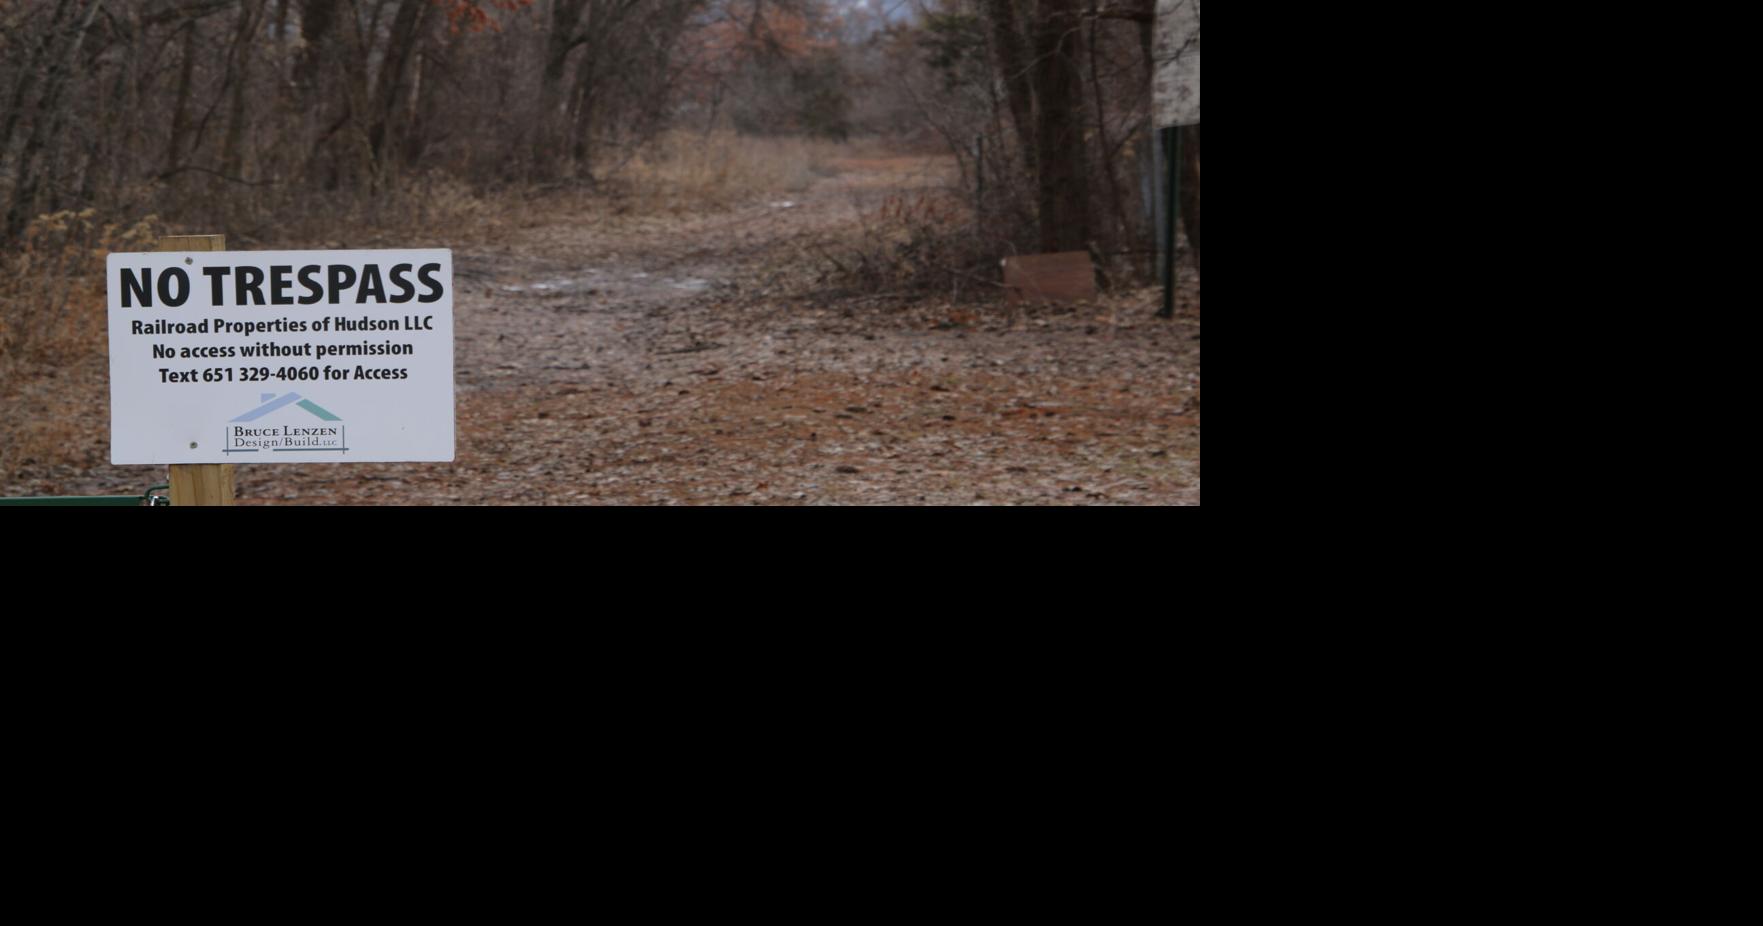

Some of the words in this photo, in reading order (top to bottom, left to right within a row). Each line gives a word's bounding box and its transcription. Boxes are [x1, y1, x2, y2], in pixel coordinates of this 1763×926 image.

[119, 265, 191, 309] NO
[203, 262, 444, 307] TRESPASS
[131, 319, 209, 335] Railroad
[213, 318, 308, 337] Properties
[311, 316, 331, 333] of
[334, 316, 400, 332] Hudson
[404, 315, 434, 331] LLC
[152, 344, 176, 359] No
[179, 346, 236, 358] access
[239, 341, 312, 358] without
[315, 339, 414, 360] permission
[158, 368, 199, 384] Text
[202, 367, 234, 383] 651
[239, 366, 320, 382] 329-4060
[322, 364, 350, 381] for
[353, 364, 409, 381] Access
[234, 425, 279, 437] BRUCE
[283, 425, 337, 436] LENZEN
